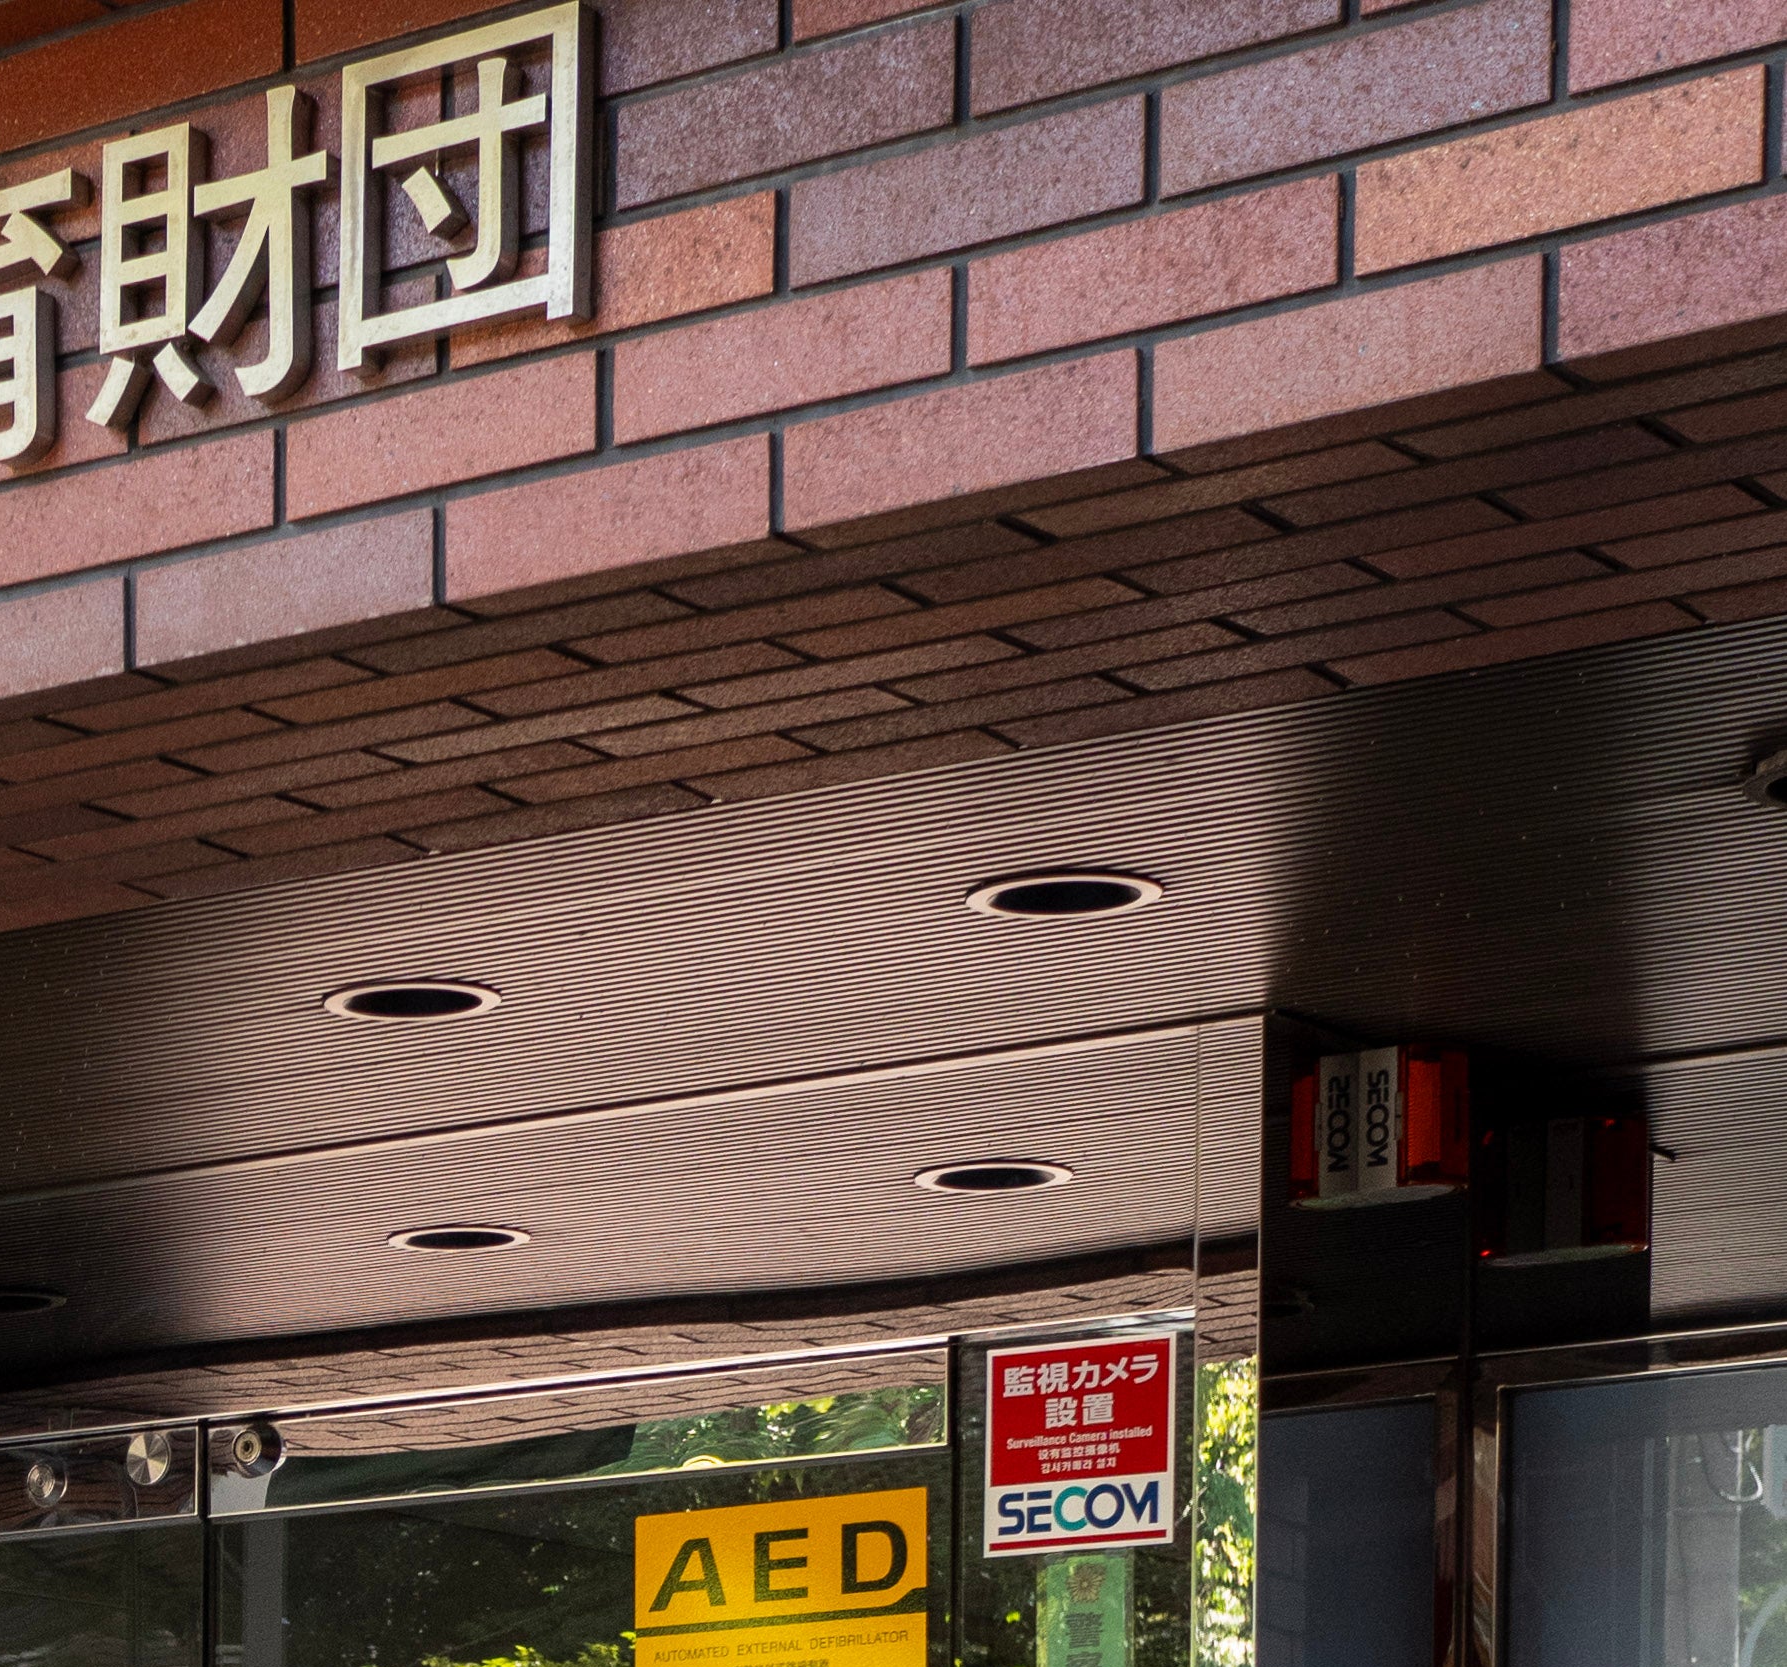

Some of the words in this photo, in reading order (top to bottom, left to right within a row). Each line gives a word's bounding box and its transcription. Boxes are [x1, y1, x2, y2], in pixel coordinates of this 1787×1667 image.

[1367, 1069, 1390, 1168] SECOM
[1003, 1353, 1159, 1398] 監視カメラ
[1045, 1392, 1114, 1429] 設置
[1006, 1434, 1067, 1450] Surveillance
[1069, 1430, 1107, 1444] Camera
[1109, 1425, 1153, 1441] installed
[998, 1480, 1159, 1536] SECOM
[648, 1520, 908, 1613] AED
[654, 1645, 729, 1663] AUTOMATED
[737, 1639, 803, 1657] EXTERNAL
[810, 1630, 909, 1650] DEFIBRILLATOR
